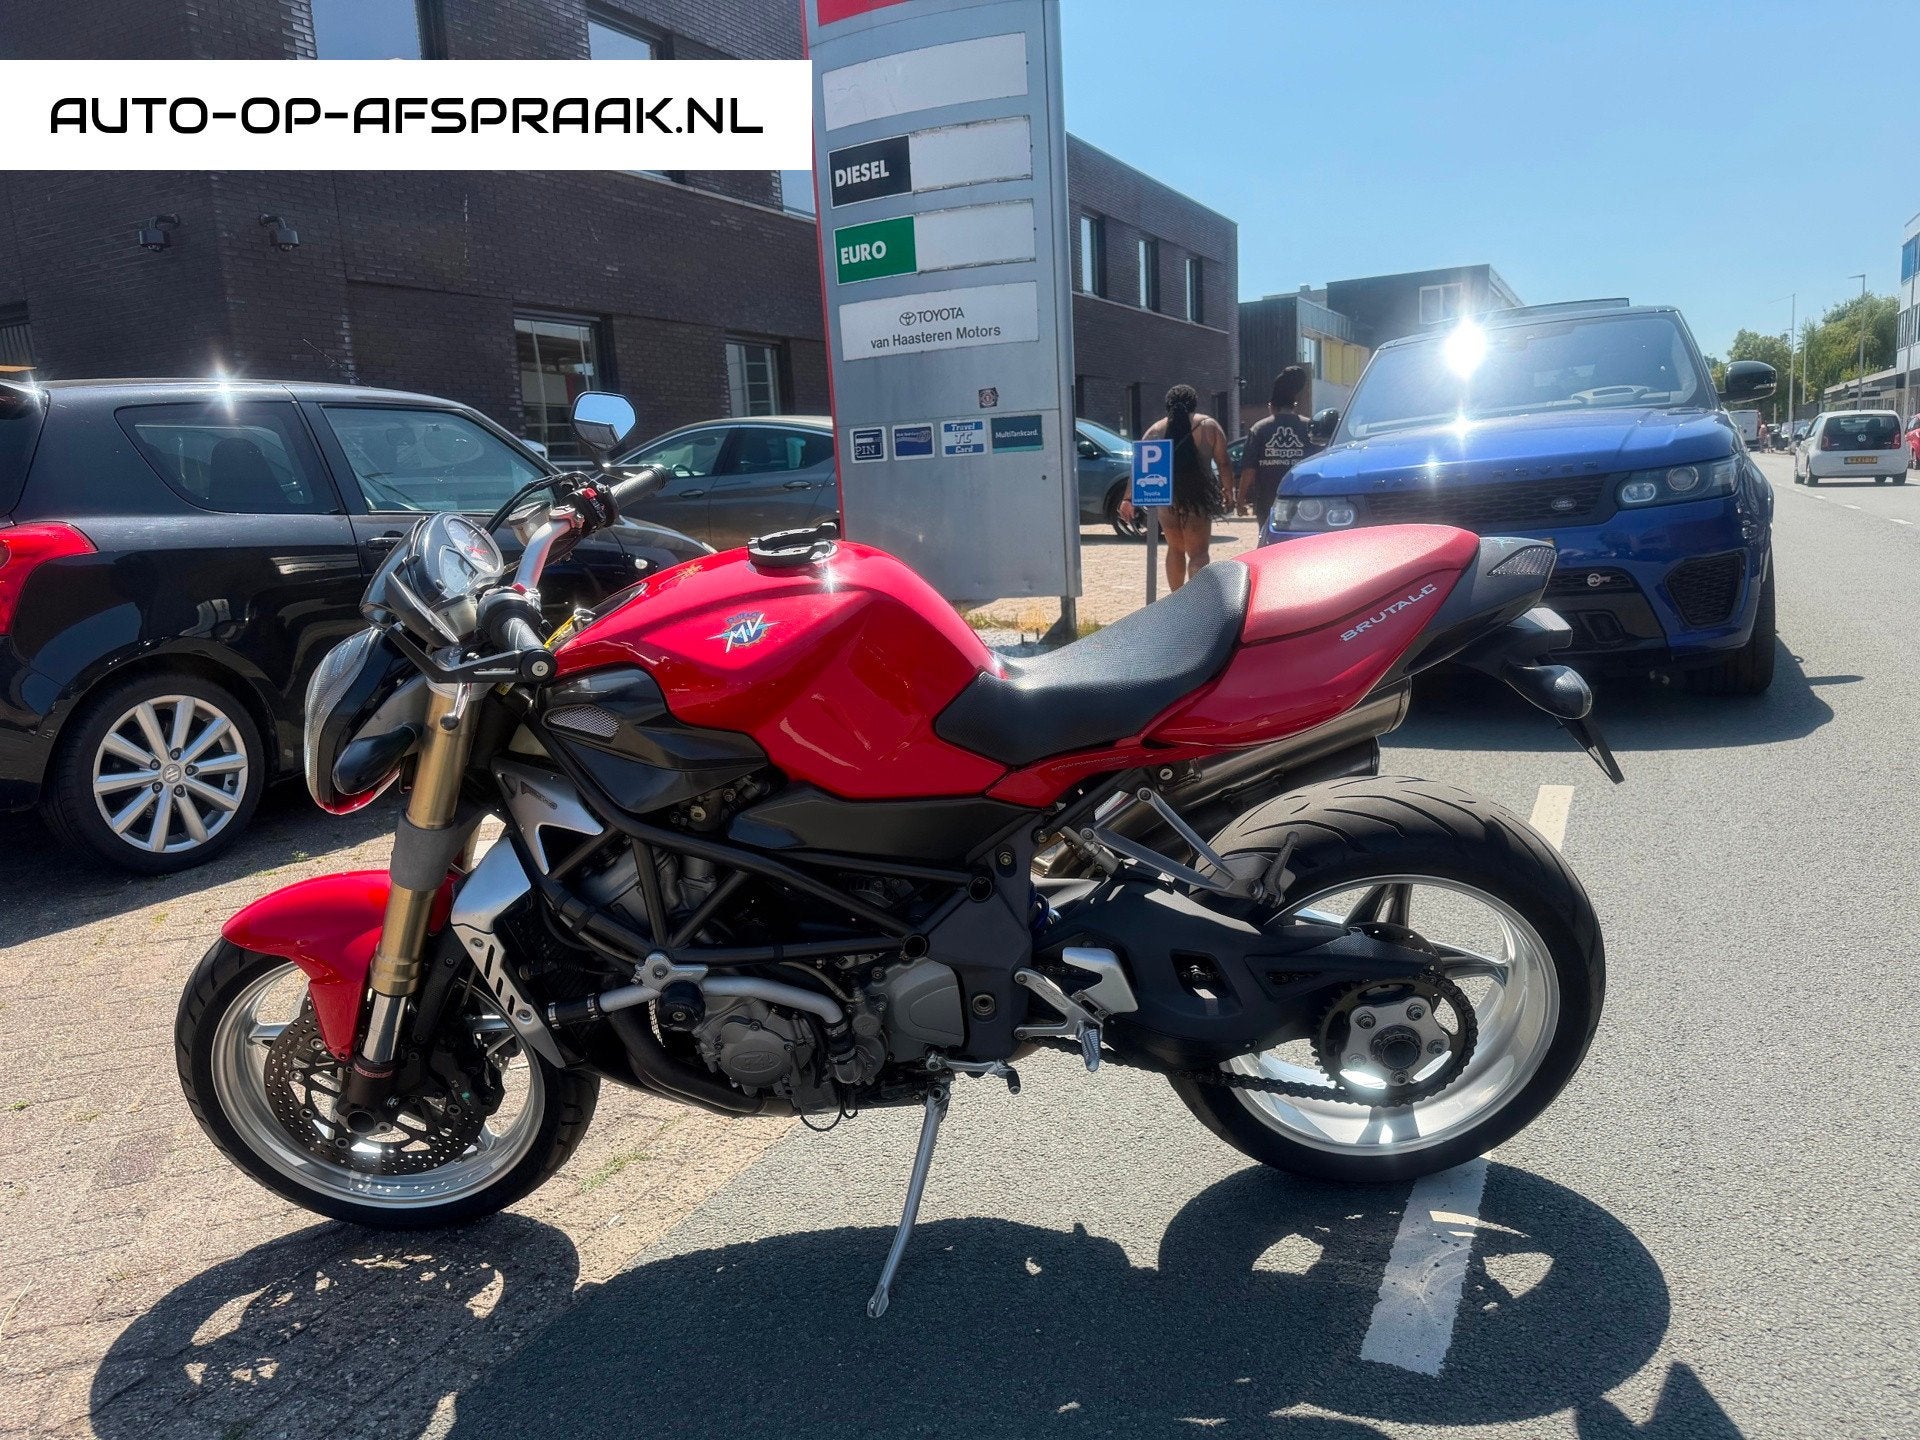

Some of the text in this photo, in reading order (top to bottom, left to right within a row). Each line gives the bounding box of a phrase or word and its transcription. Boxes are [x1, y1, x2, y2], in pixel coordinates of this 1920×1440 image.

[835, 160, 890, 188] DIESEL
[840, 240, 887, 265] EURO
[917, 306, 965, 323] TOYOTA
[870, 325, 1001, 349] van Haasteren Motors
[954, 432, 973, 444] TC
[1141, 445, 1162, 473] P
[1340, 583, 1437, 641] BRUTALE
